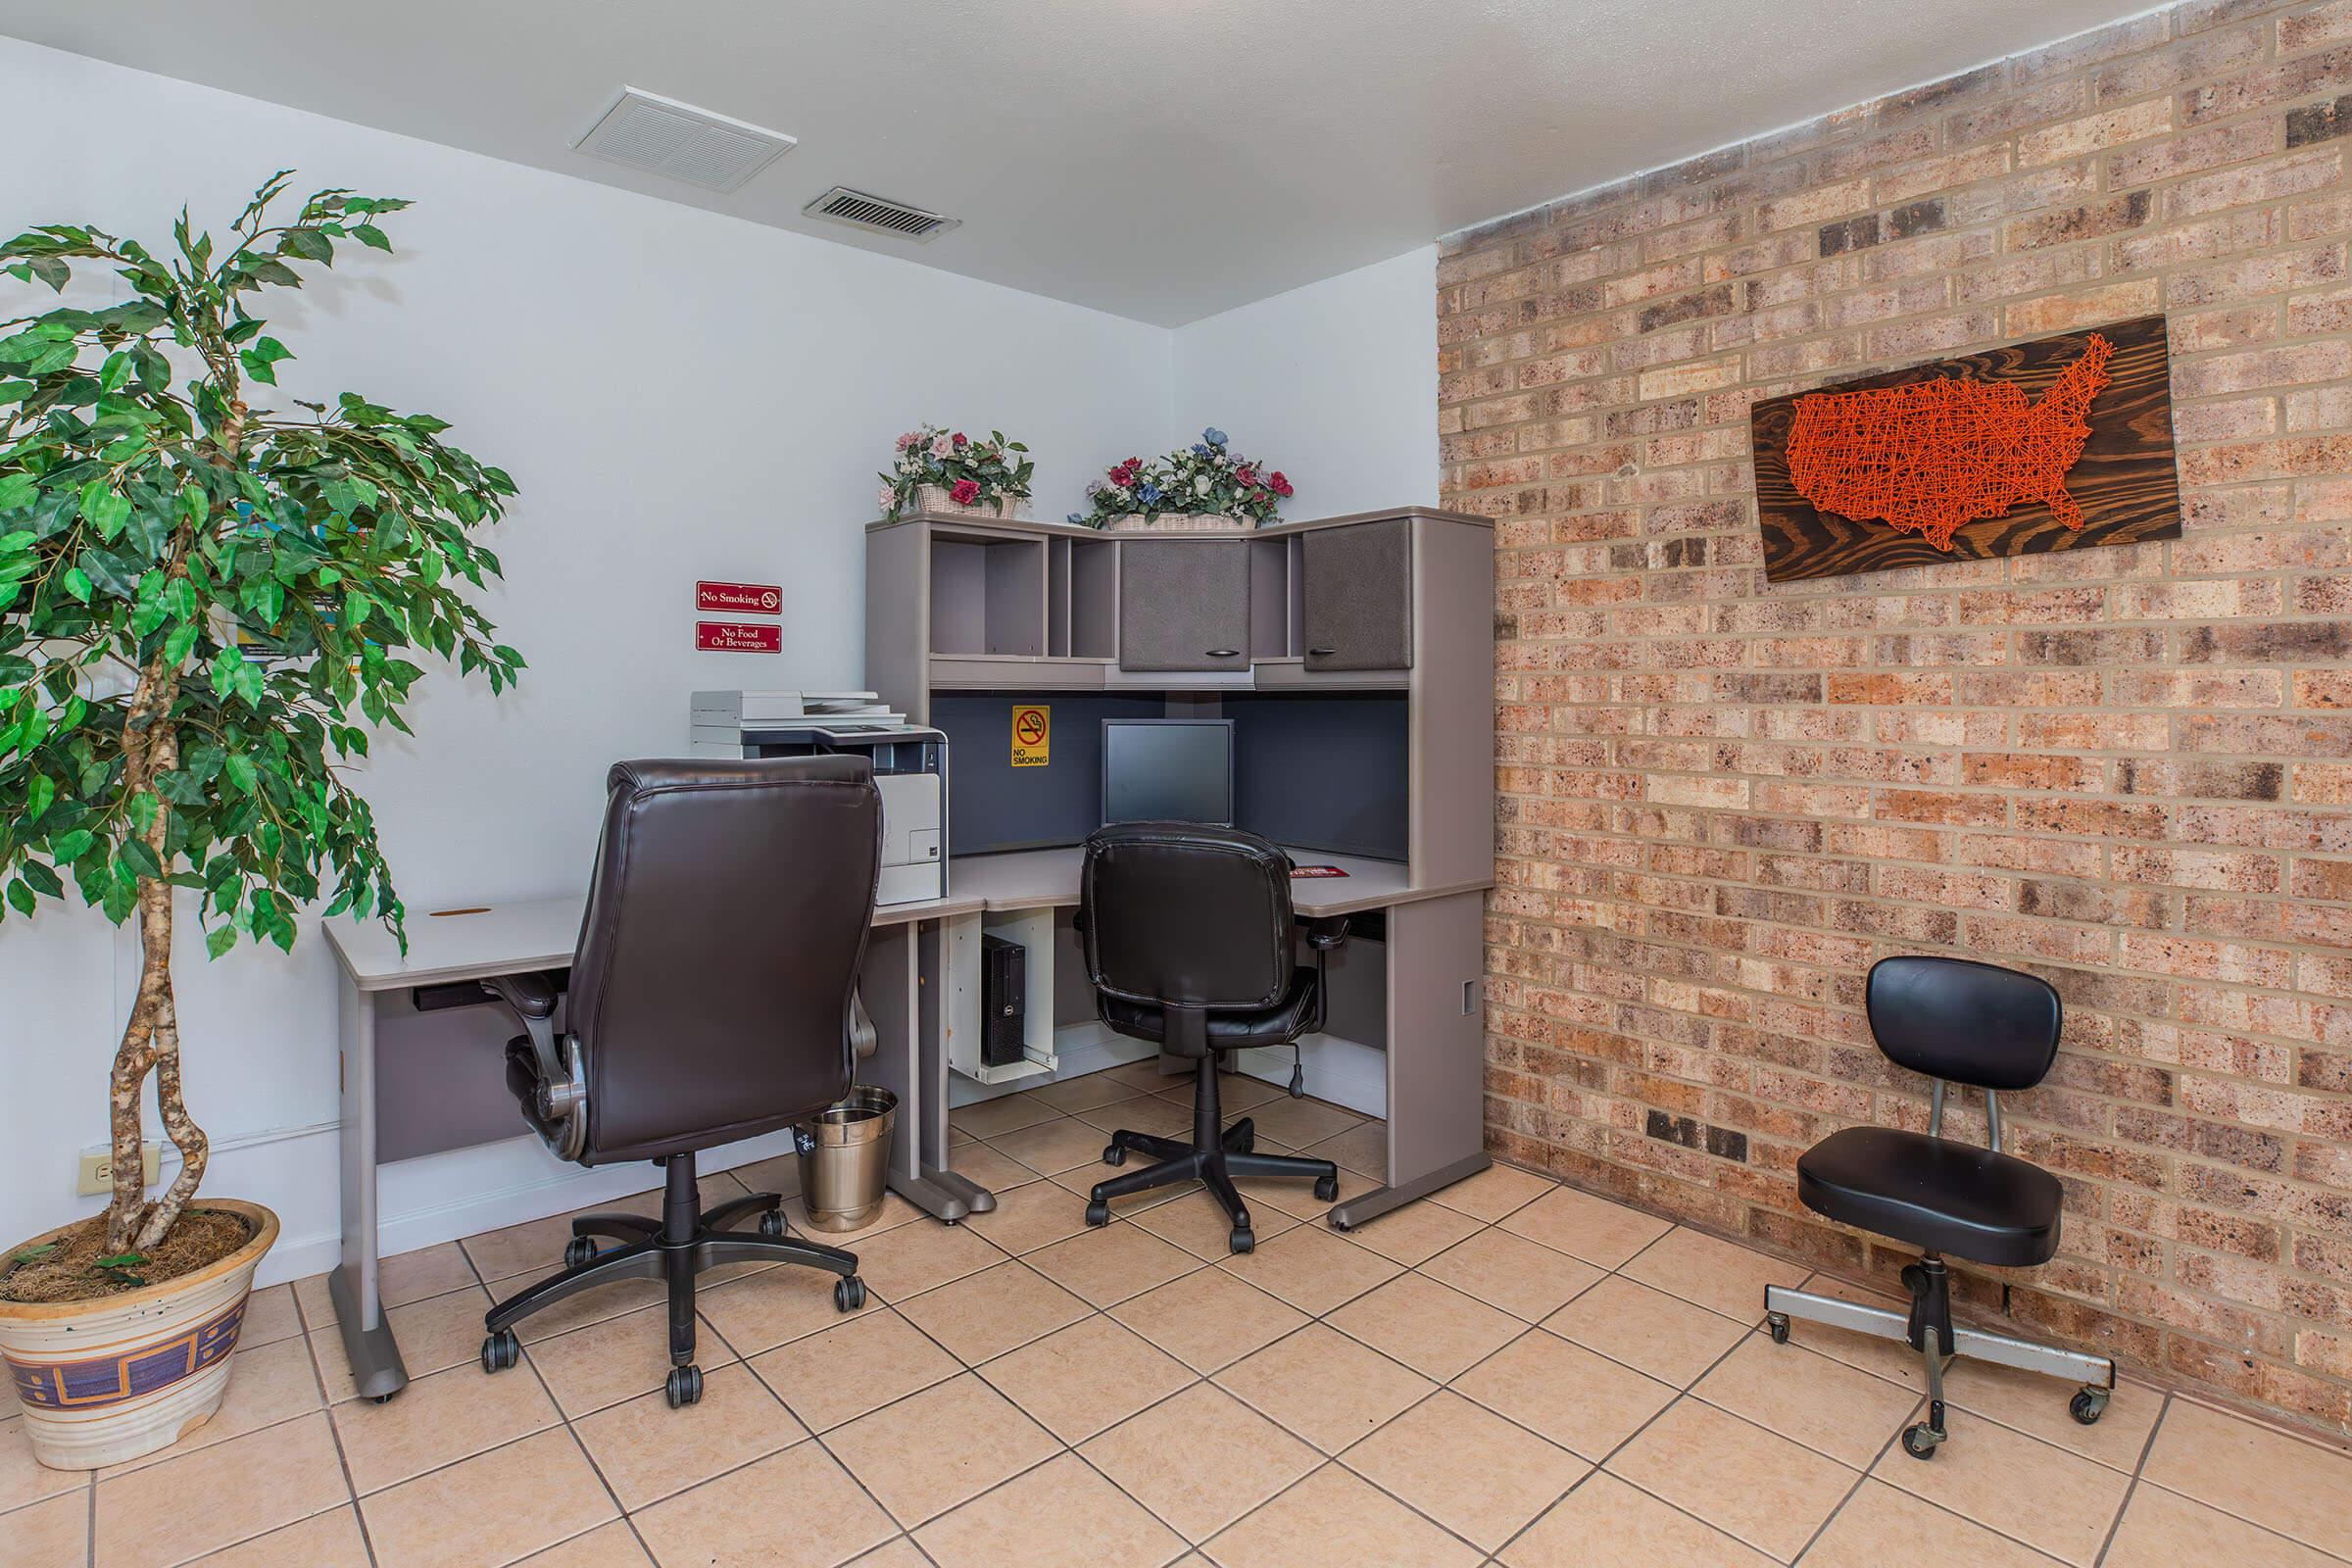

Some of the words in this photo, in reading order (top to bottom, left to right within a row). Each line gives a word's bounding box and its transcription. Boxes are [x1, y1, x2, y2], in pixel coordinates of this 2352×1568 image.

[701, 591, 717, 602] No
[719, 592, 760, 606] Smoking
[721, 627, 736, 638] No
[738, 628, 759, 638] Food
[711, 636, 724, 646] Or
[726, 637, 767, 649] Beverages
